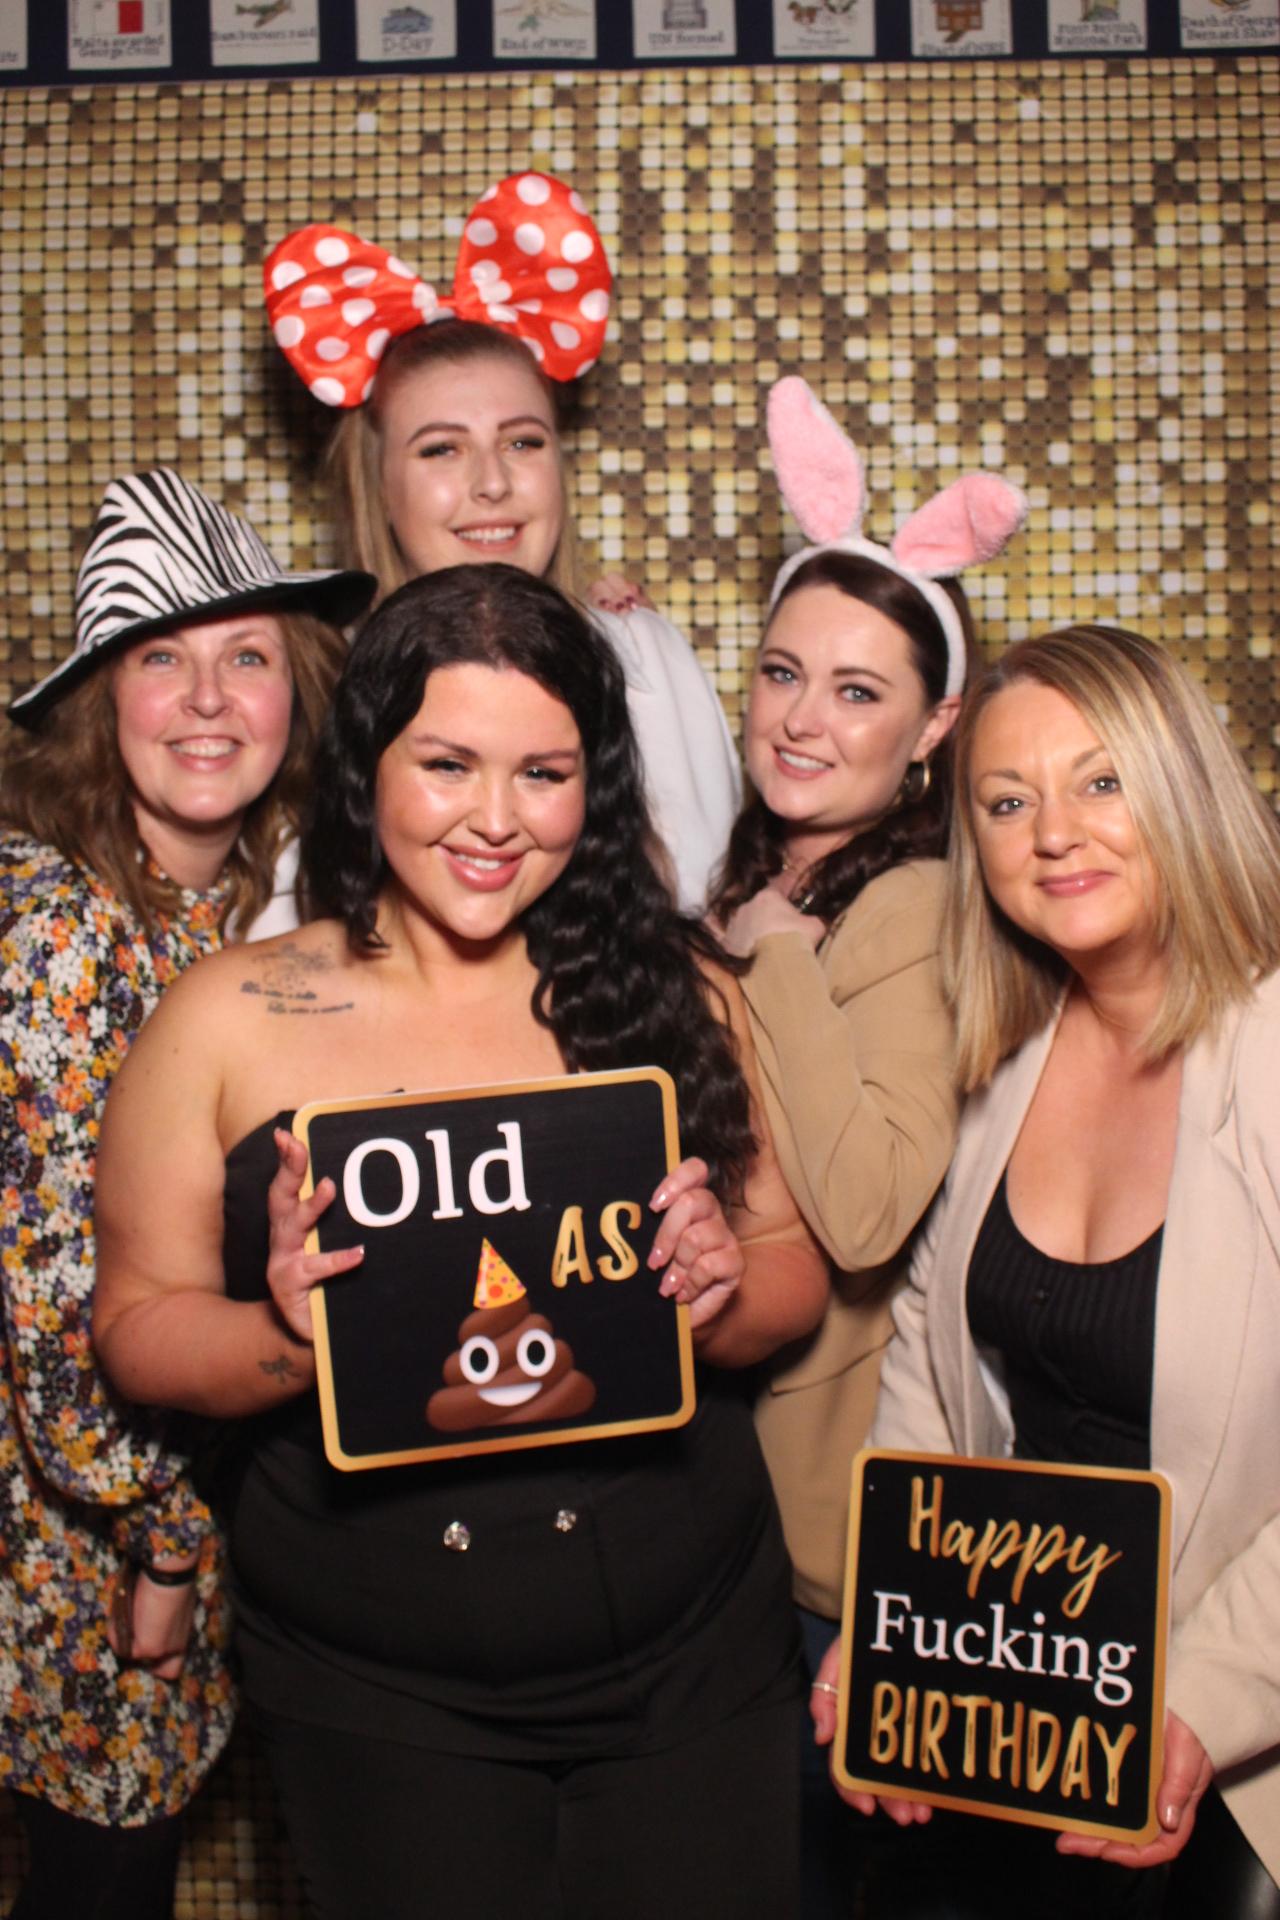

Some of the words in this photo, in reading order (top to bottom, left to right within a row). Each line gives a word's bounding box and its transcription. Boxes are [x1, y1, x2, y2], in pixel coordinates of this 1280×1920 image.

[381, 36, 433, 51] D-Day
[343, 1121, 532, 1227] Old
[551, 1200, 641, 1288] AS
[908, 1474, 1122, 1619] Happy
[869, 1591, 1137, 1706] Fucking
[869, 1681, 1137, 1807] BIRTHDAY
